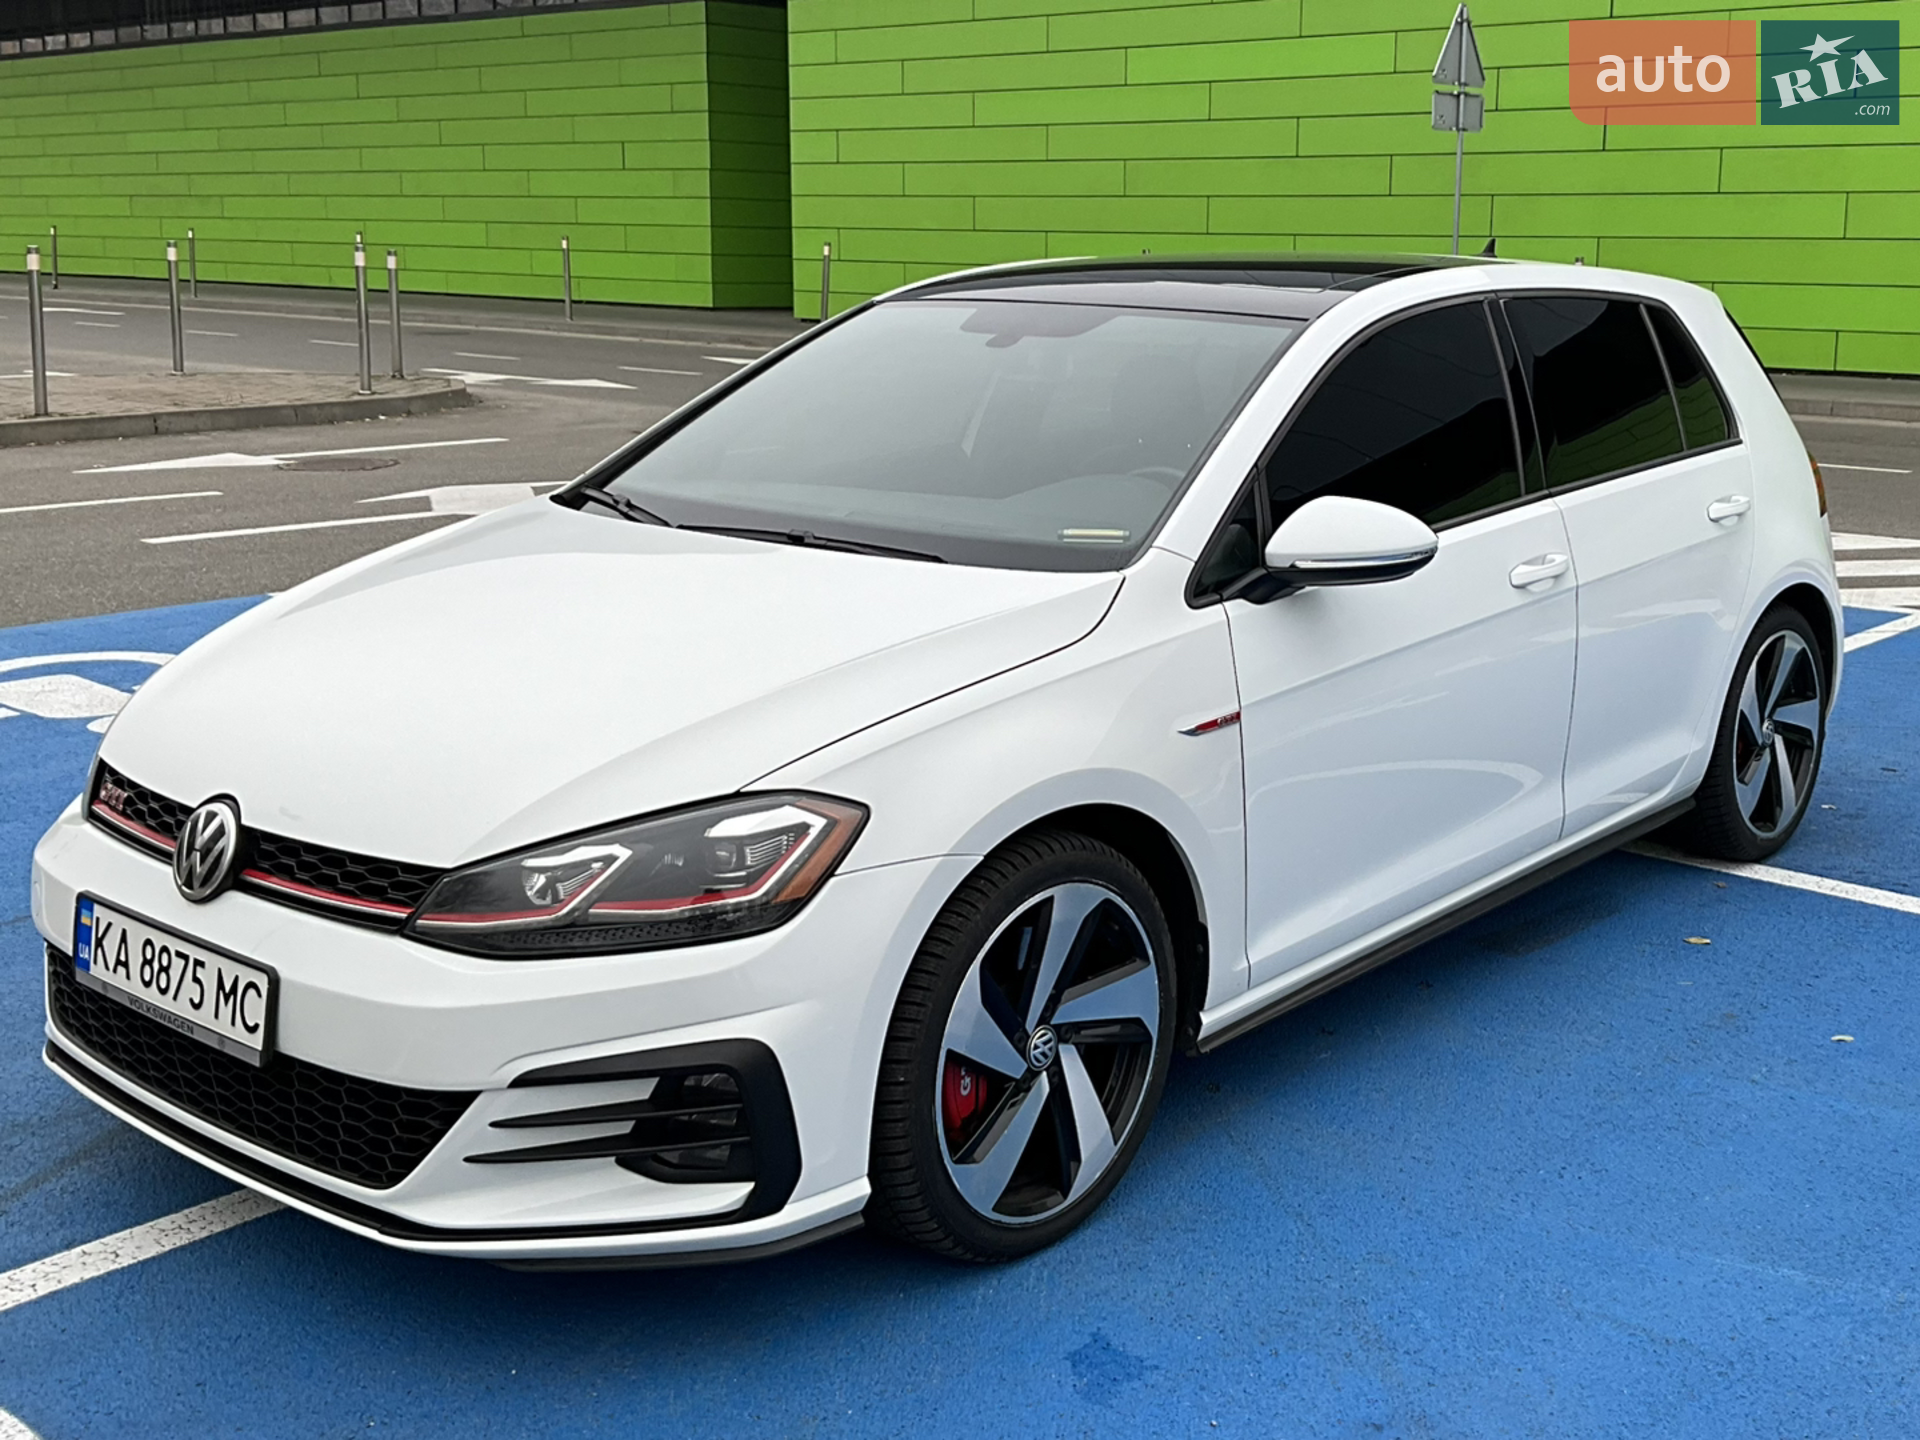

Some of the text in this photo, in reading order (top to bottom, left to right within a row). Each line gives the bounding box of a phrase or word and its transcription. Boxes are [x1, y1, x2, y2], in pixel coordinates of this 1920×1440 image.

[78, 942, 90, 961] UA
[93, 916, 262, 1034] KA 8875 MC
[127, 996, 194, 1036] VOLKSWAGEN
